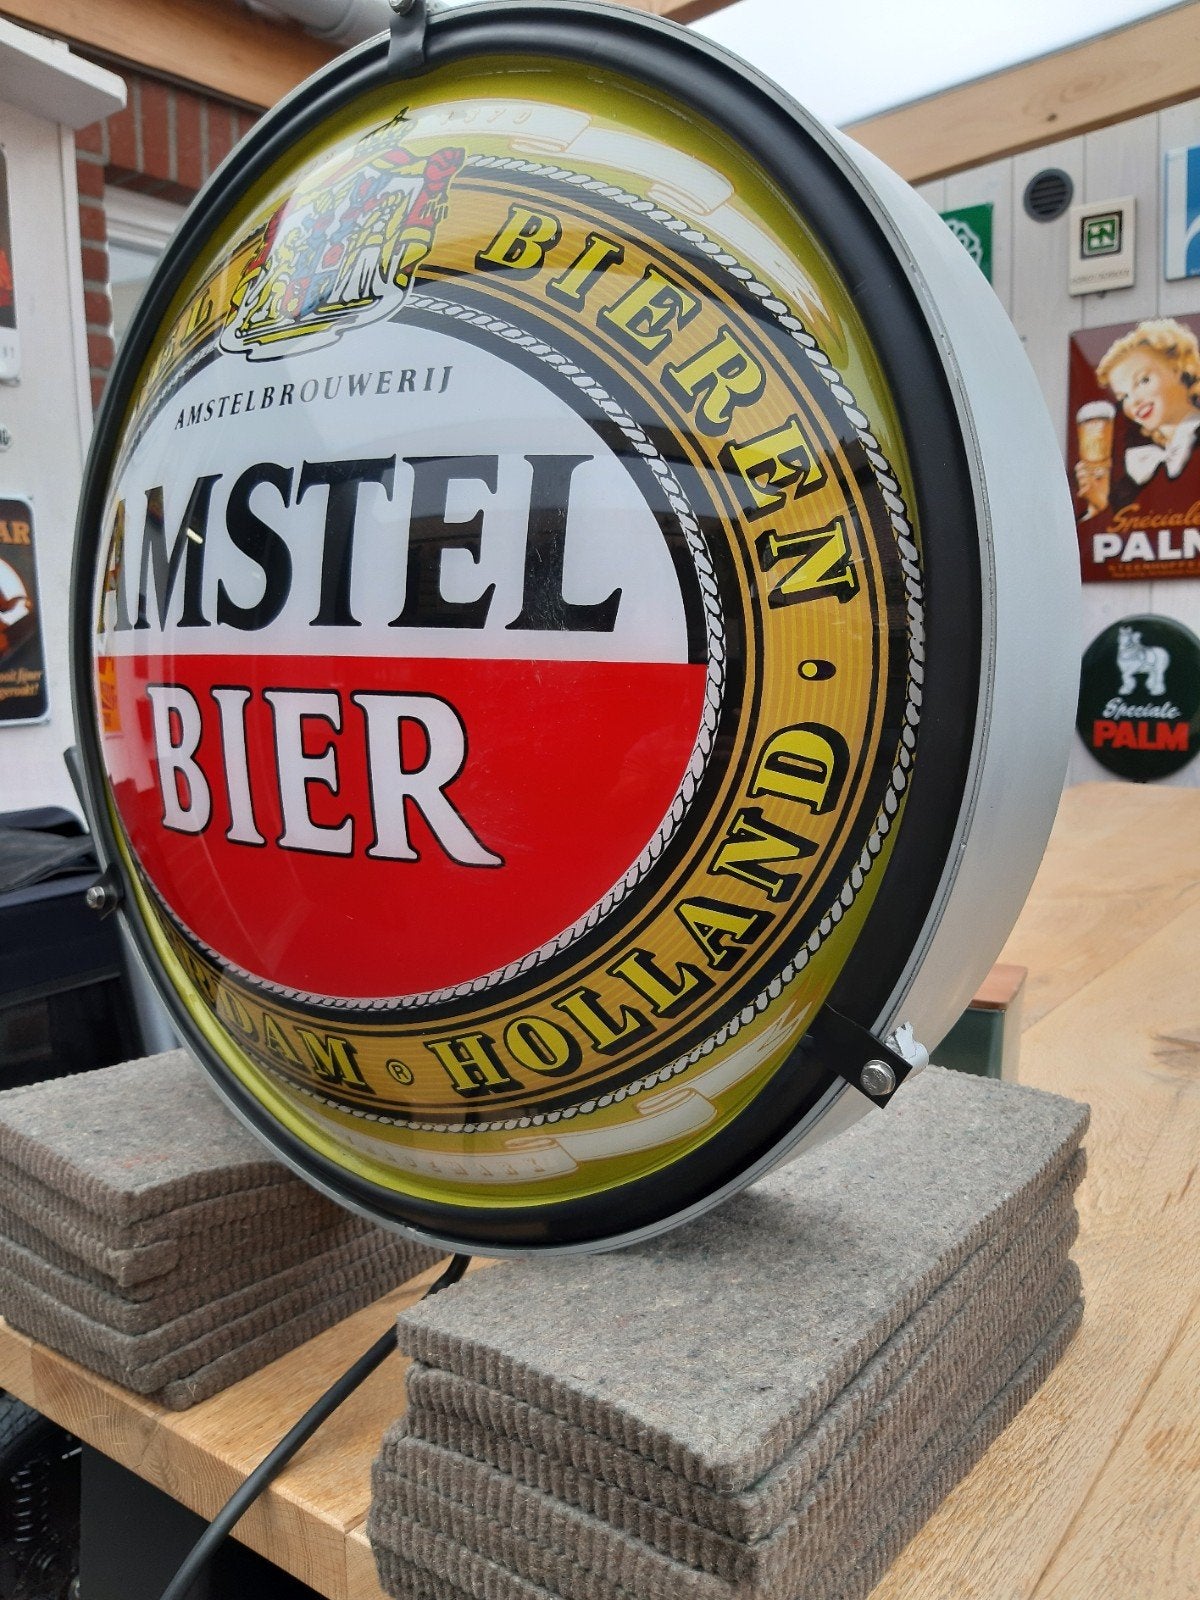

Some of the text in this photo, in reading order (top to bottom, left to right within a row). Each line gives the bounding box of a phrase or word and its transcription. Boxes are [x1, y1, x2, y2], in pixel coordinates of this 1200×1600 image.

[174, 364, 454, 430] AMSTELBROUWERIJ
[475, 203, 861, 610] BIEREN
[97, 453, 622, 633] AMSTEL
[146, 683, 505, 867] BIER
[1093, 719, 1189, 752] PALM
[1102, 697, 1182, 720] Speciale
[427, 721, 851, 1099] HOLLAND
